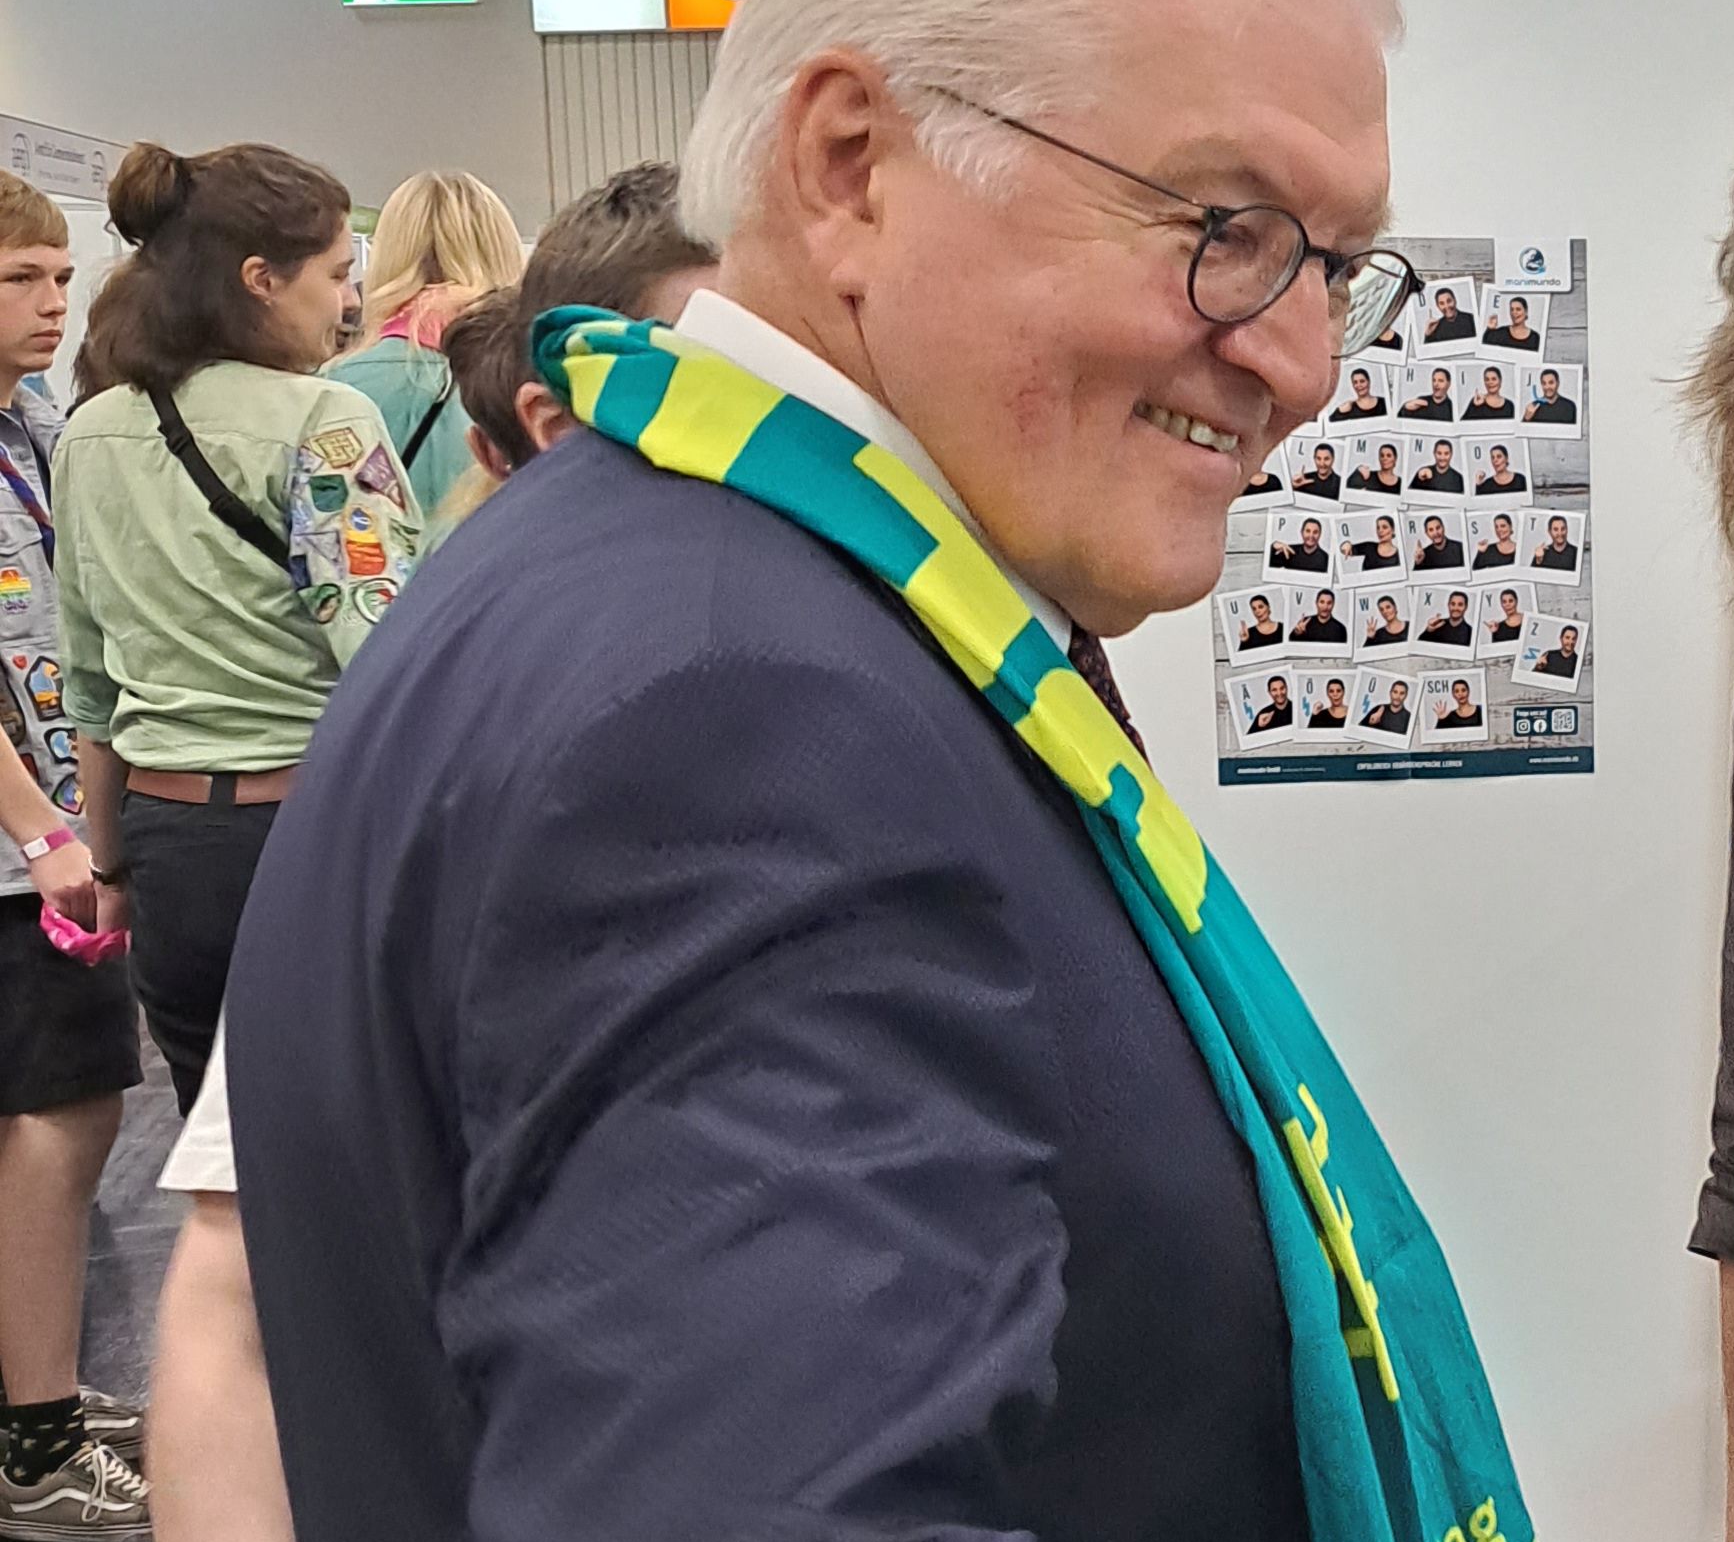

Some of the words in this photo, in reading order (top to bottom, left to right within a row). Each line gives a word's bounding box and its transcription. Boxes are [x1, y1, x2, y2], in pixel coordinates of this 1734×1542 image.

[1494, 295, 1501, 308] E
[1406, 368, 1414, 382] H
[1527, 373, 1532, 386] J
[1298, 442, 1304, 455] L
[1356, 439, 1366, 453] M
[1414, 439, 1423, 452] N
[1278, 518, 1286, 531] P
[1342, 523, 1349, 536] Q
[1409, 520, 1416, 534] R
[1471, 521, 1479, 534] S
[1530, 518, 1536, 530] T
[1230, 601, 1238, 614] U
[1296, 592, 1303, 605] V
[1359, 598, 1370, 611] W
[1423, 593, 1432, 606] X
[1485, 594, 1493, 607] Y
[1530, 622, 1539, 636] Z
[1427, 679, 1449, 693] SCH
